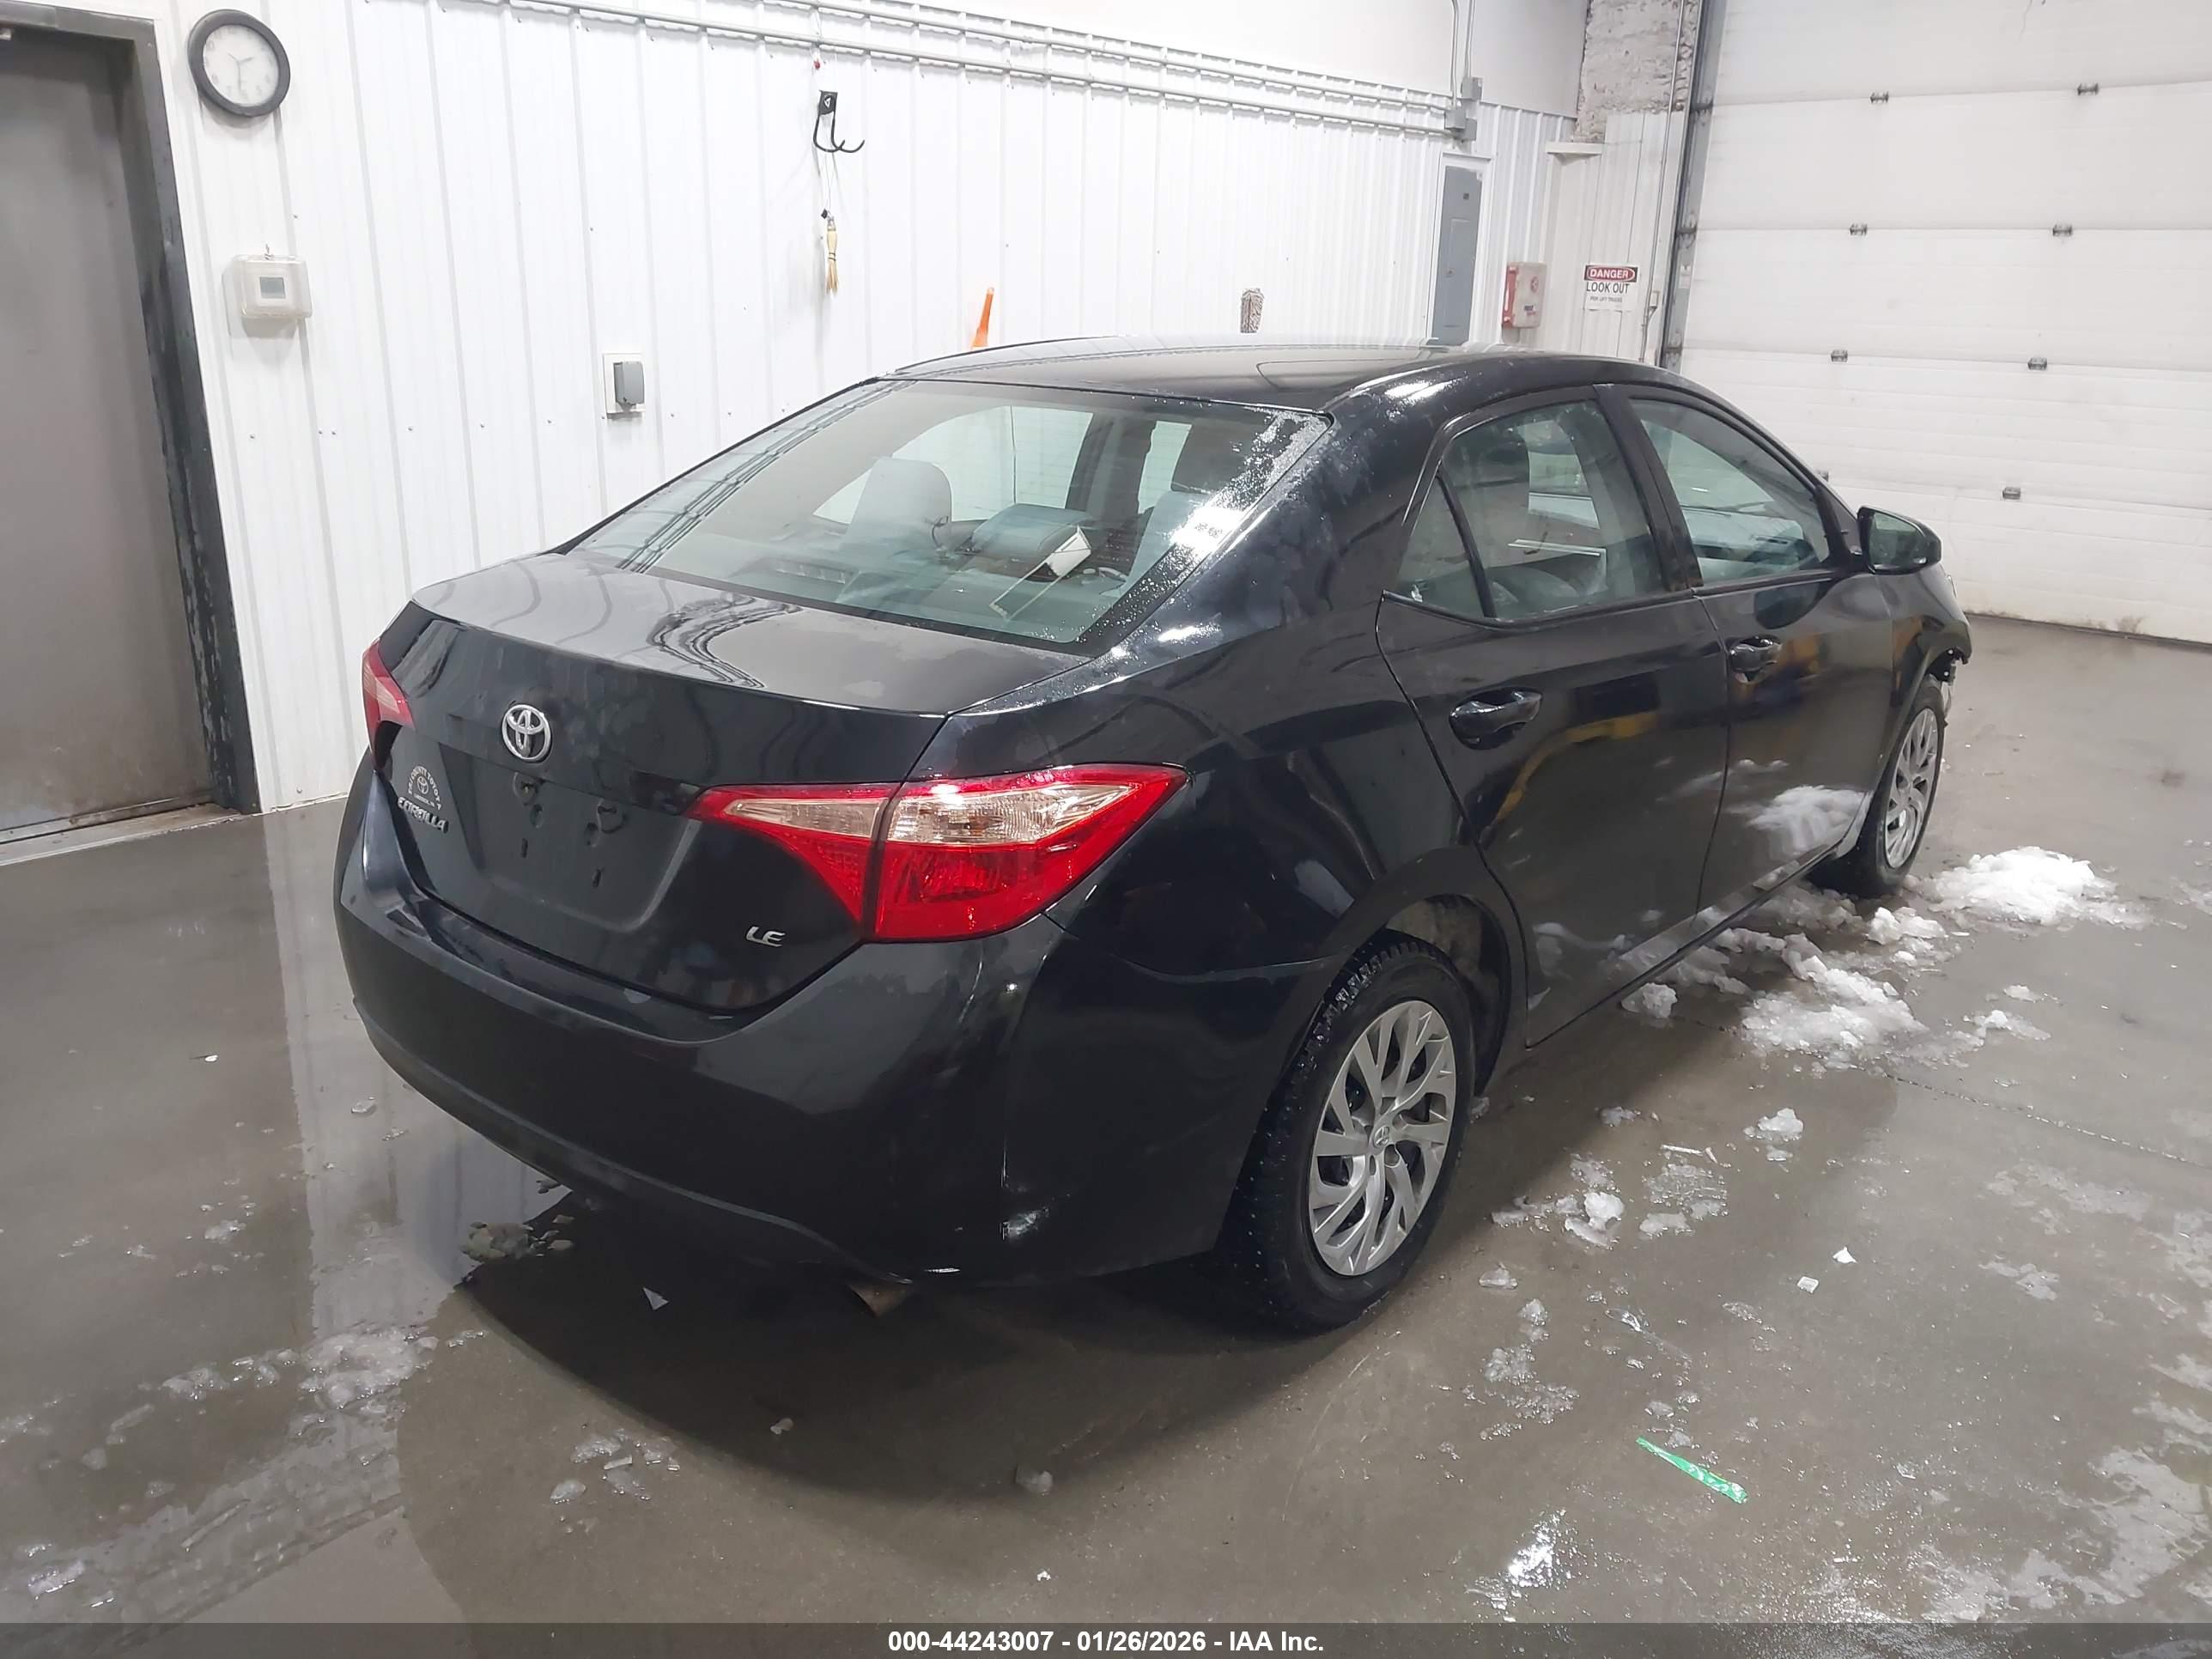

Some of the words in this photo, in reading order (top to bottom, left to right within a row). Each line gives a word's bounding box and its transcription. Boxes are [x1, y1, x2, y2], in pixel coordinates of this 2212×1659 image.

[1589, 268, 1629, 279] DANGER
[1586, 282, 1610, 293] LOOK
[1613, 283, 1630, 294] OUT
[428, 772, 441, 811] TOYOTA
[398, 797, 447, 832] COROLLA
[746, 926, 786, 947] LE
